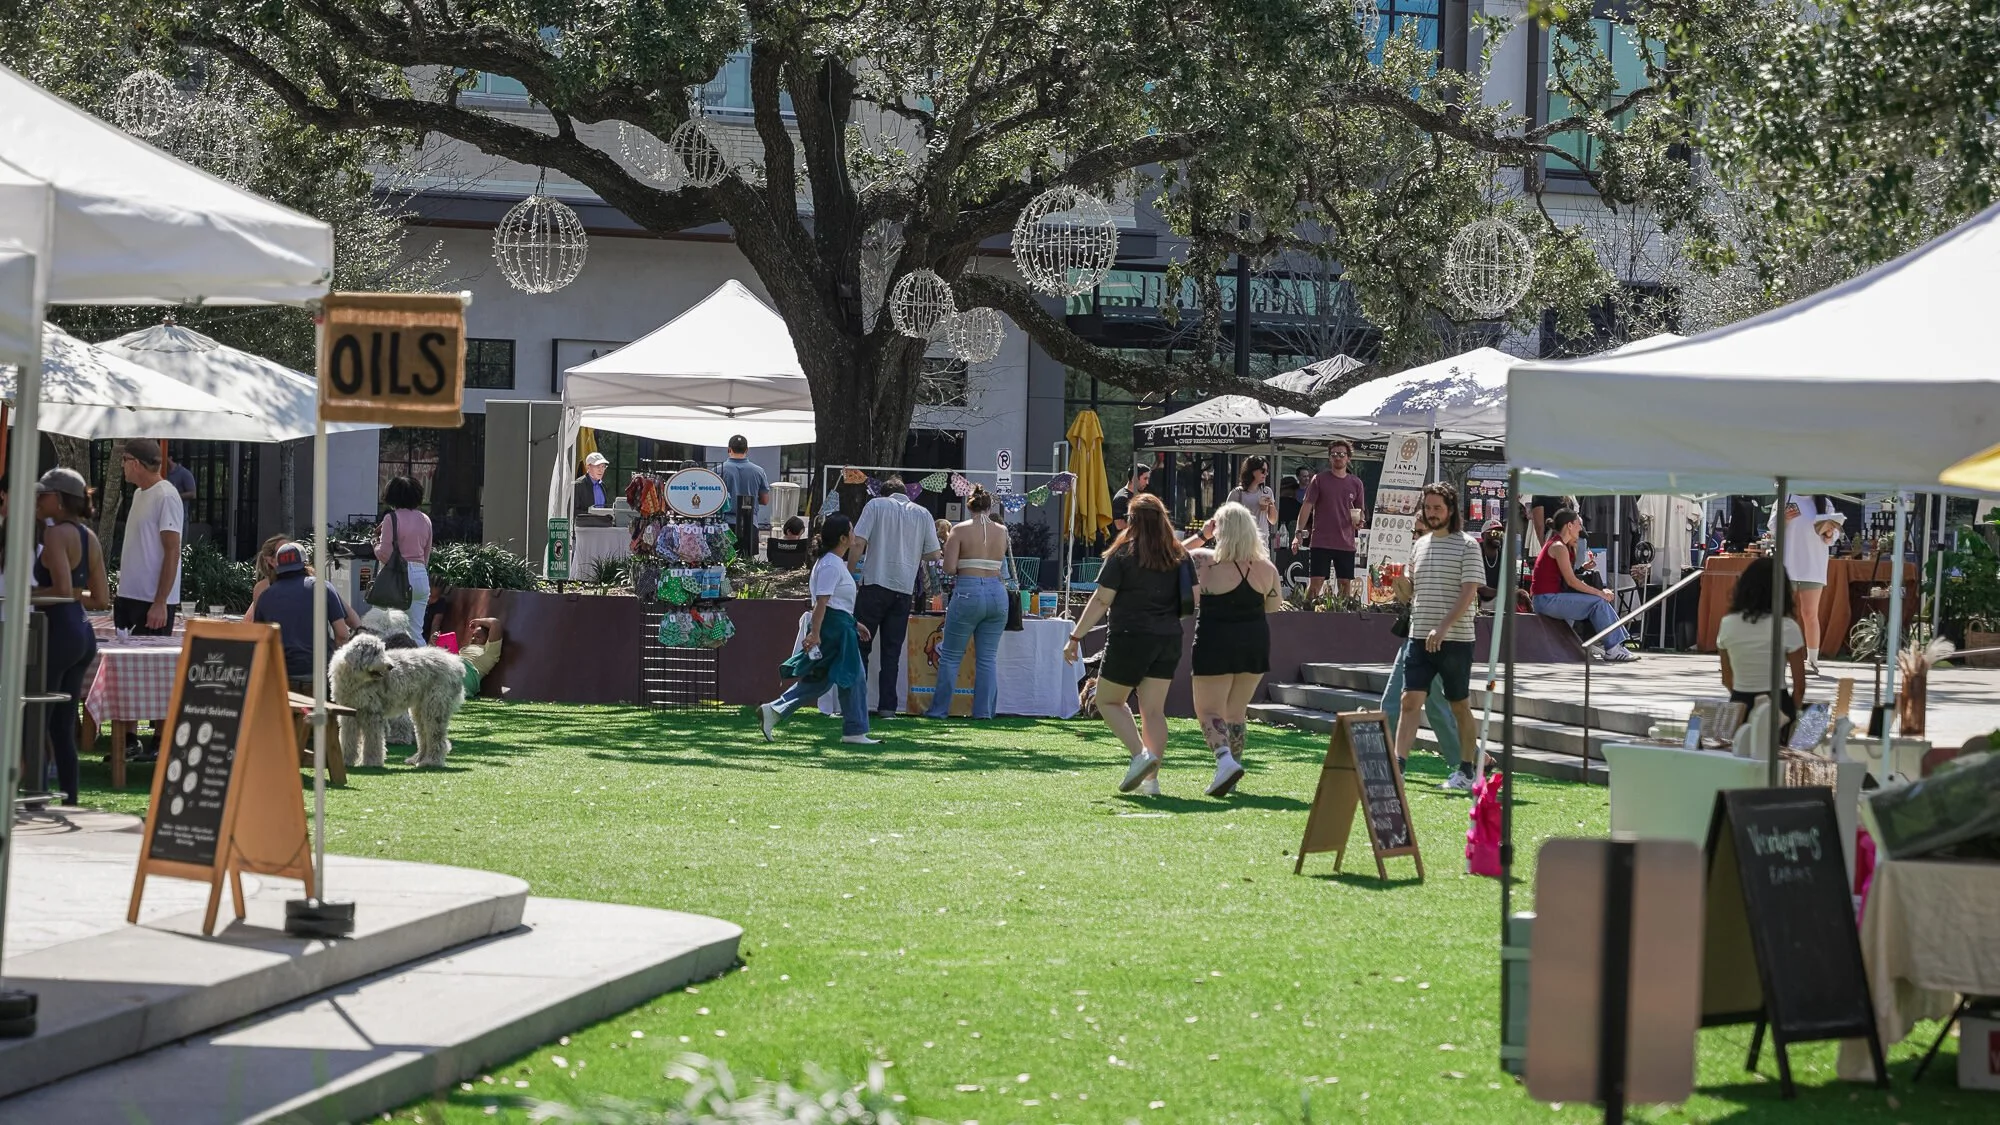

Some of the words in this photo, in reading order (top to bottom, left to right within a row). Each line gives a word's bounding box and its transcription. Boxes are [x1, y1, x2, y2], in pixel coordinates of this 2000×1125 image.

[331, 331, 446, 396] OILS
[1160, 423, 1193, 438] THE
[1195, 422, 1251, 438] SMOKE
[1360, 443, 1368, 451] by
[1369, 443, 1388, 451] CHE
[1440, 449, 1469, 457] SCOTT
[550, 561, 567, 570] ZONE
